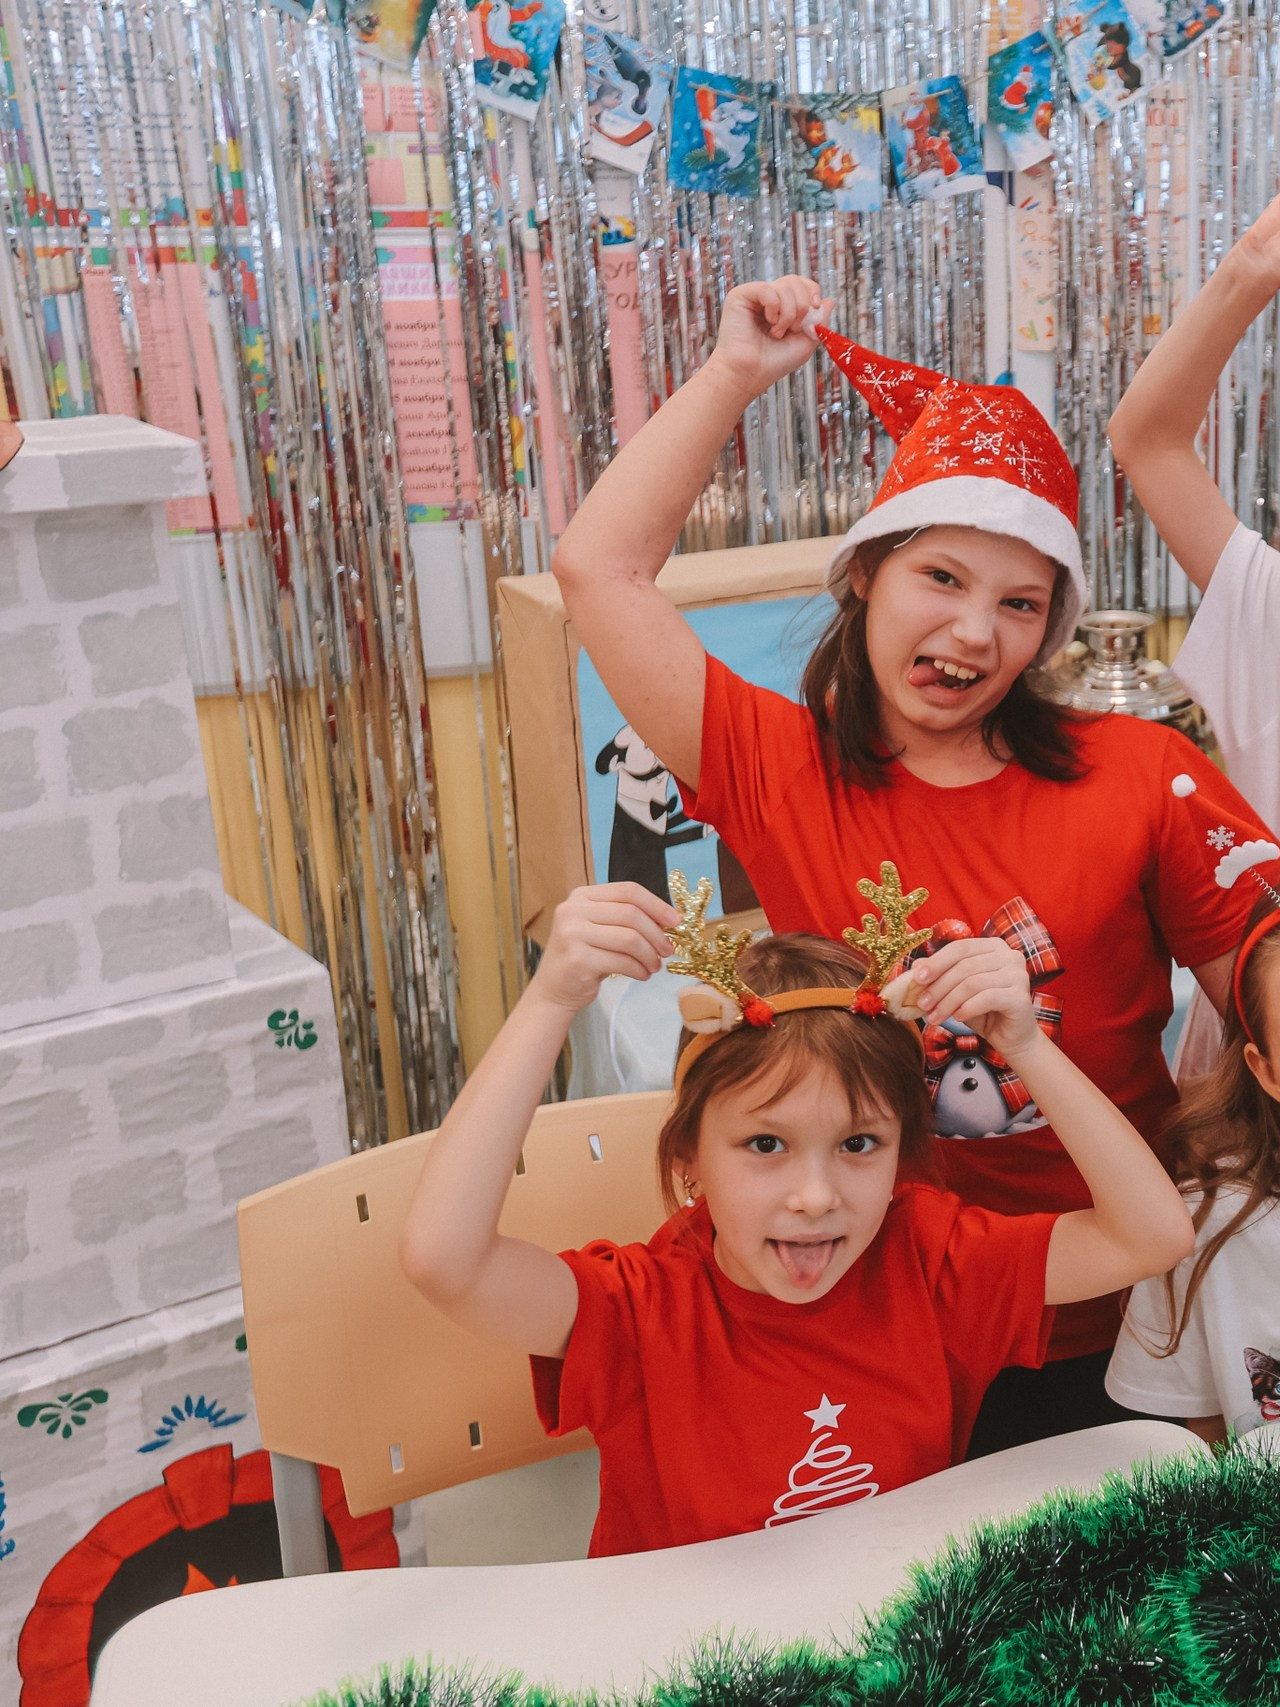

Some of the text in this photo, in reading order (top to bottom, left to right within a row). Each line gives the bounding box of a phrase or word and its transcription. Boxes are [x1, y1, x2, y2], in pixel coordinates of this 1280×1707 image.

[395, 320, 437, 331] ноября
[399, 356, 441, 368] ноября
[404, 392, 445, 404] ноября
